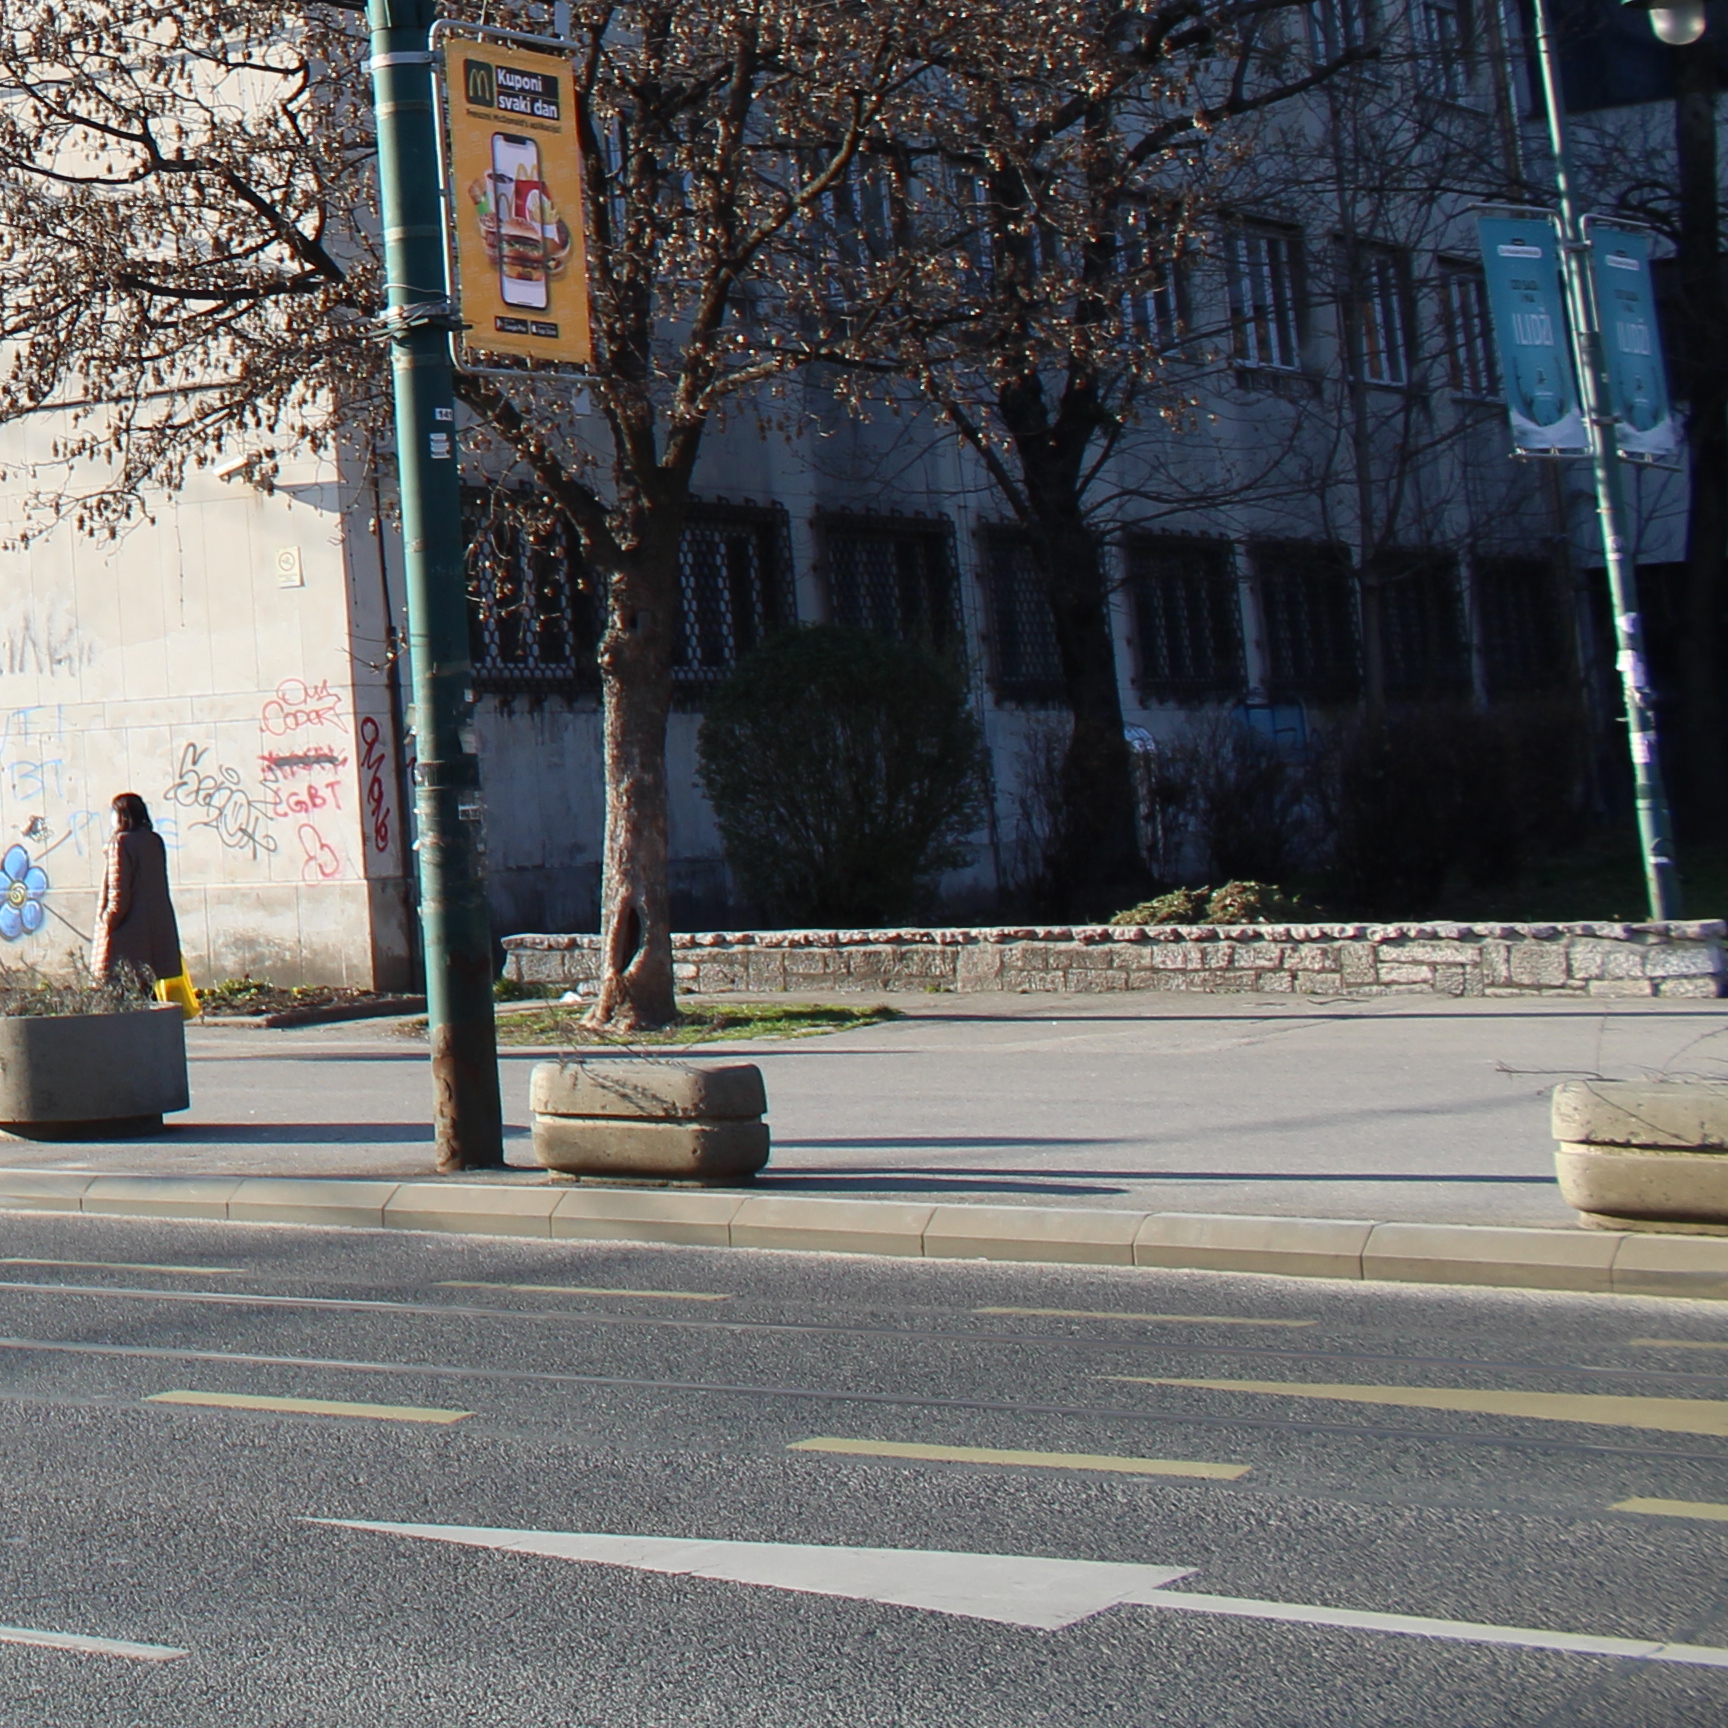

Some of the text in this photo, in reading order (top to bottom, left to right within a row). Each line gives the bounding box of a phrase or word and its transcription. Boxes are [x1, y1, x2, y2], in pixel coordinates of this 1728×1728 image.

[497, 68, 542, 92] Kuponi
[498, 94, 558, 119] svaki dan
